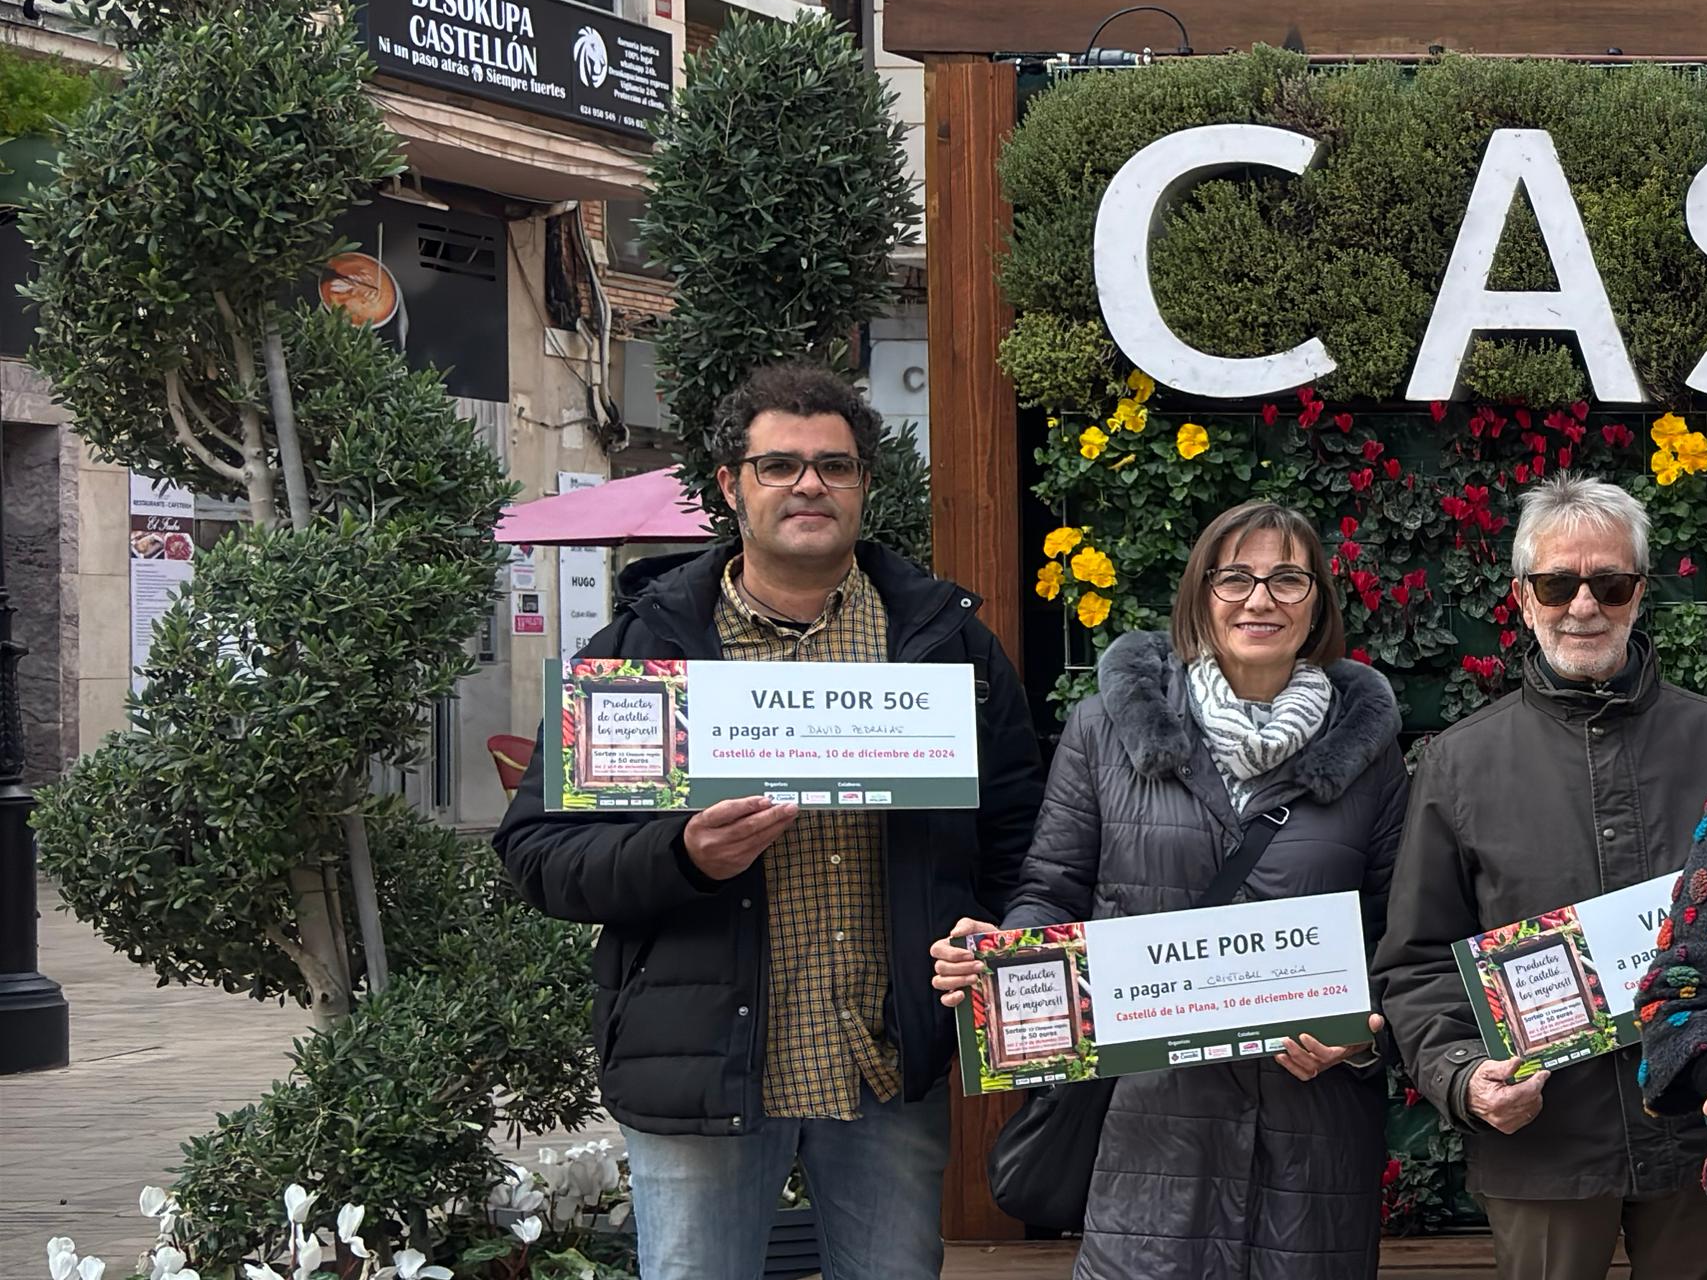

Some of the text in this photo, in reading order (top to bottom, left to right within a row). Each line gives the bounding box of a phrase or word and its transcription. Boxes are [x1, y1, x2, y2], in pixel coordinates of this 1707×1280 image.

[409, 15, 537, 76] CASTELLÓN
[378, 36, 566, 99] Ni un paso atrás Siempre fuertes
[571, 577, 596, 587] HUGO
[750, 689, 929, 710] VALE POR 50€
[597, 711, 609, 721] de
[597, 724, 612, 734] los
[711, 725, 794, 740] a pagar a
[712, 748, 954, 758] Castelló de la Plana, 10 de diciembre de 2024
[1638, 907, 1670, 932] VA
[1146, 926, 1320, 964] VALE POR 50€
[1113, 979, 1192, 1001] a pagar a
